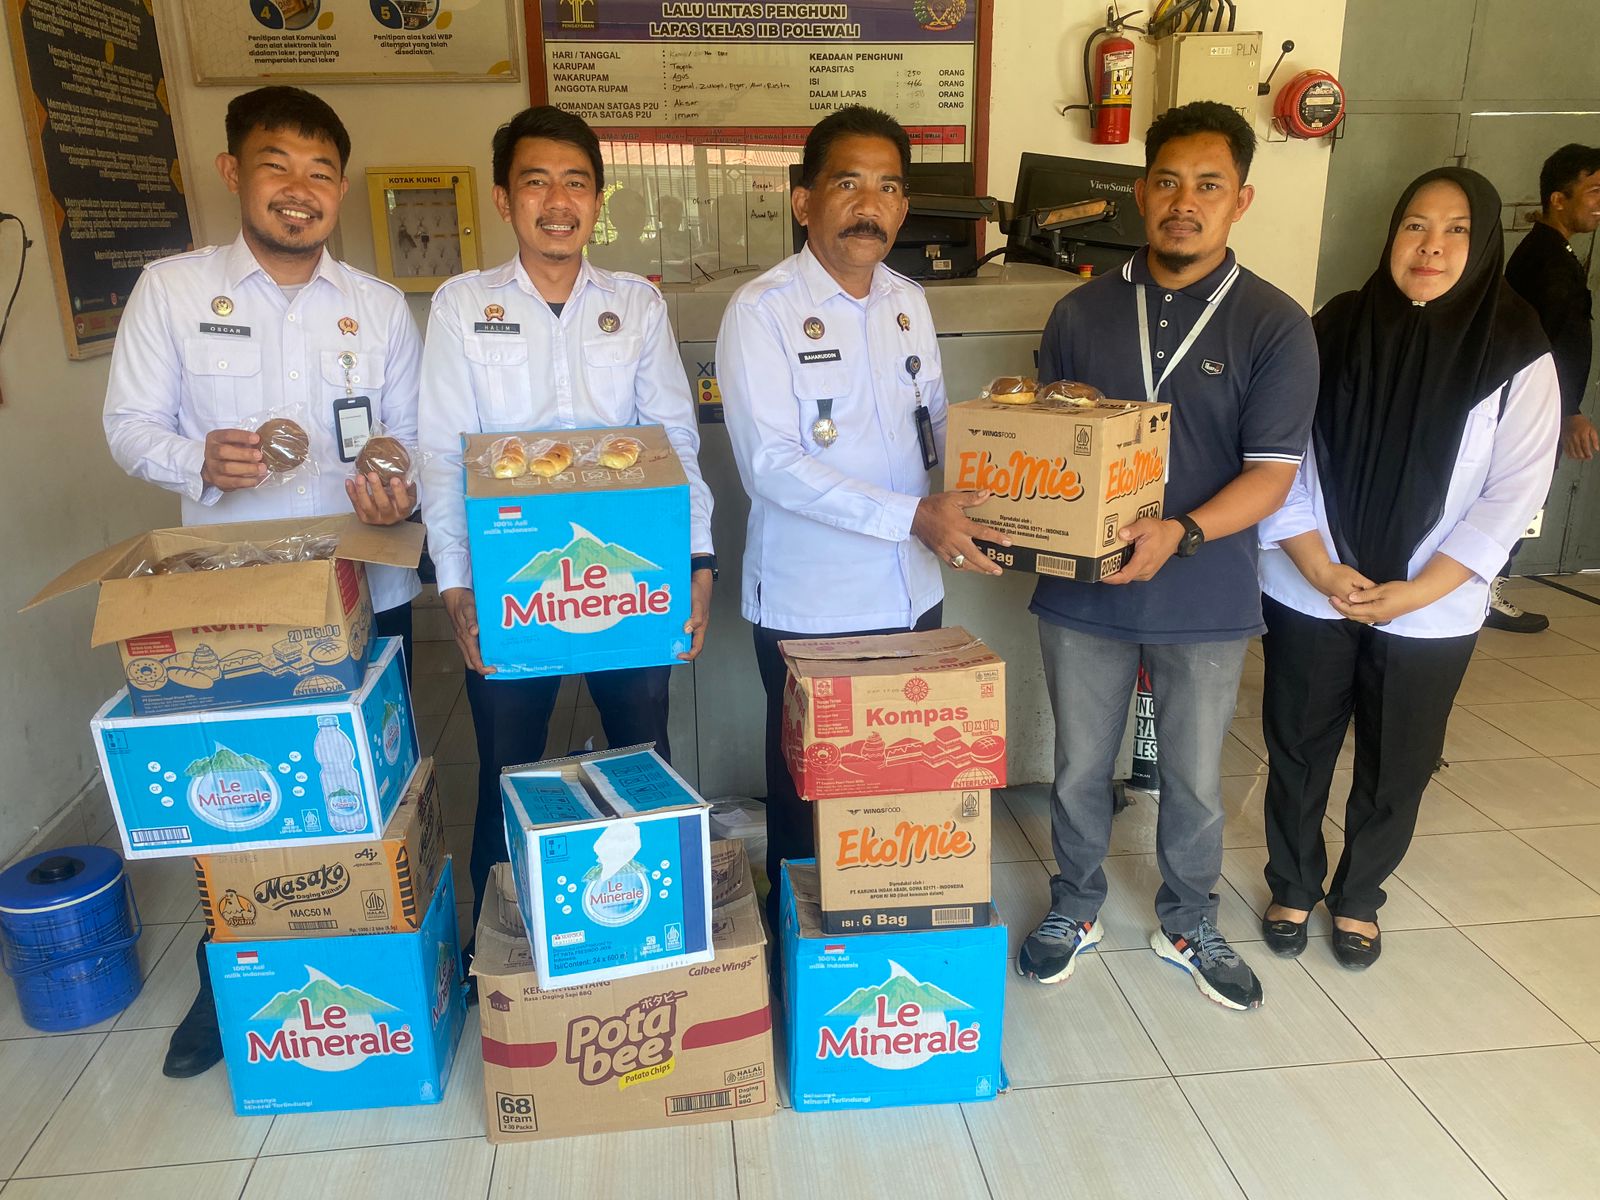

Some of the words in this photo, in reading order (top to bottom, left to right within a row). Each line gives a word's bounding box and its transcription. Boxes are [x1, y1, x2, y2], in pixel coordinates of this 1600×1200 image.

[260, 6, 271, 20] 4
[380, 6, 391, 20] 5
[663, 3, 703, 18] LALU
[707, 4, 762, 18] LINTAS
[766, 5, 847, 19] PENGHUNI
[650, 22, 702, 37] LAPAS
[703, 23, 754, 38] KELAS
[758, 24, 780, 38] IIB
[783, 24, 860, 39] POLEWALI
[248, 34, 281, 42] Penitipan
[373, 34, 406, 42] Penitipan
[380, 41, 411, 50] ditempat
[411, 42, 430, 50] yang
[1236, 43, 1259, 57] PLN
[298, 49, 340, 59] pengunjung
[552, 51, 573, 59] HARI
[579, 51, 621, 59] TANGGAL
[809, 53, 854, 61] KEADAAN
[856, 53, 904, 61] PENGHUNI
[553, 62, 596, 70] KARUPAM
[809, 65, 855, 73] KAPASITAS
[553, 73, 609, 82] WAKARUPAM
[554, 84, 596, 93] ANGGOTA
[598, 85, 628, 93] RUPAM
[809, 90, 839, 98] DALAM
[840, 90, 867, 98] LAPAS
[555, 102, 605, 110] KOMANDAN
[607, 102, 641, 110] SATGAS
[643, 102, 659, 110] P2U
[809, 102, 832, 110] LUAR
[938, 101, 964, 109] ORANG
[600, 111, 634, 119] SATGAS
[635, 111, 652, 119] P2U
[1089, 179, 1135, 194] ViewSonic
[209, 326, 241, 334] OSCAR
[803, 352, 837, 361] BAHARUDDIN
[982, 430, 1016, 440] WINGSFOOD
[956, 450, 1084, 502] EkoMie
[1105, 447, 1164, 504] EkoMie
[1046, 527, 1069, 538] INDONESIA
[1107, 524, 1113, 538] 8
[987, 547, 1014, 568] Bag
[561, 558, 607, 592] Le
[503, 582, 669, 628] Minerale
[288, 630, 302, 642] 20
[295, 685, 344, 697] INTERFLOUR
[866, 706, 968, 728] Kompas
[962, 721, 974, 733] 10
[219, 779, 241, 793] Le
[953, 777, 997, 788] INTERFLOUR
[199, 789, 271, 807] Minerale
[863, 807, 901, 815] WINGSFOOD
[836, 820, 976, 871] EkoMie
[255, 864, 345, 906] Masako
[607, 880, 623, 893] Le
[296, 891, 321, 900] Daging
[321, 884, 343, 897] Pilihan
[590, 887, 643, 906] Minerale
[289, 908, 322, 918] MAC50
[323, 907, 332, 917] M
[862, 915, 872, 926] 6
[877, 913, 908, 928] Bag
[688, 965, 721, 978] Calbee
[721, 959, 752, 973] Wings
[543, 993, 565, 1001] Daging
[565, 992, 578, 1000] Sapi
[299, 998, 346, 1031] Le
[876, 995, 921, 1028] Le
[571, 1004, 671, 1060] Pota
[248, 1023, 412, 1062] Minerale
[818, 1021, 979, 1058] Minerale
[583, 1037, 665, 1082] bee
[625, 1071, 650, 1083] Potato
[650, 1063, 670, 1077] Chips
[737, 1065, 762, 1076] HALAL
[738, 1084, 758, 1095] Daging
[738, 1092, 751, 1100] Sapi
[501, 1096, 531, 1114] 68
[502, 1114, 532, 1124] gram
